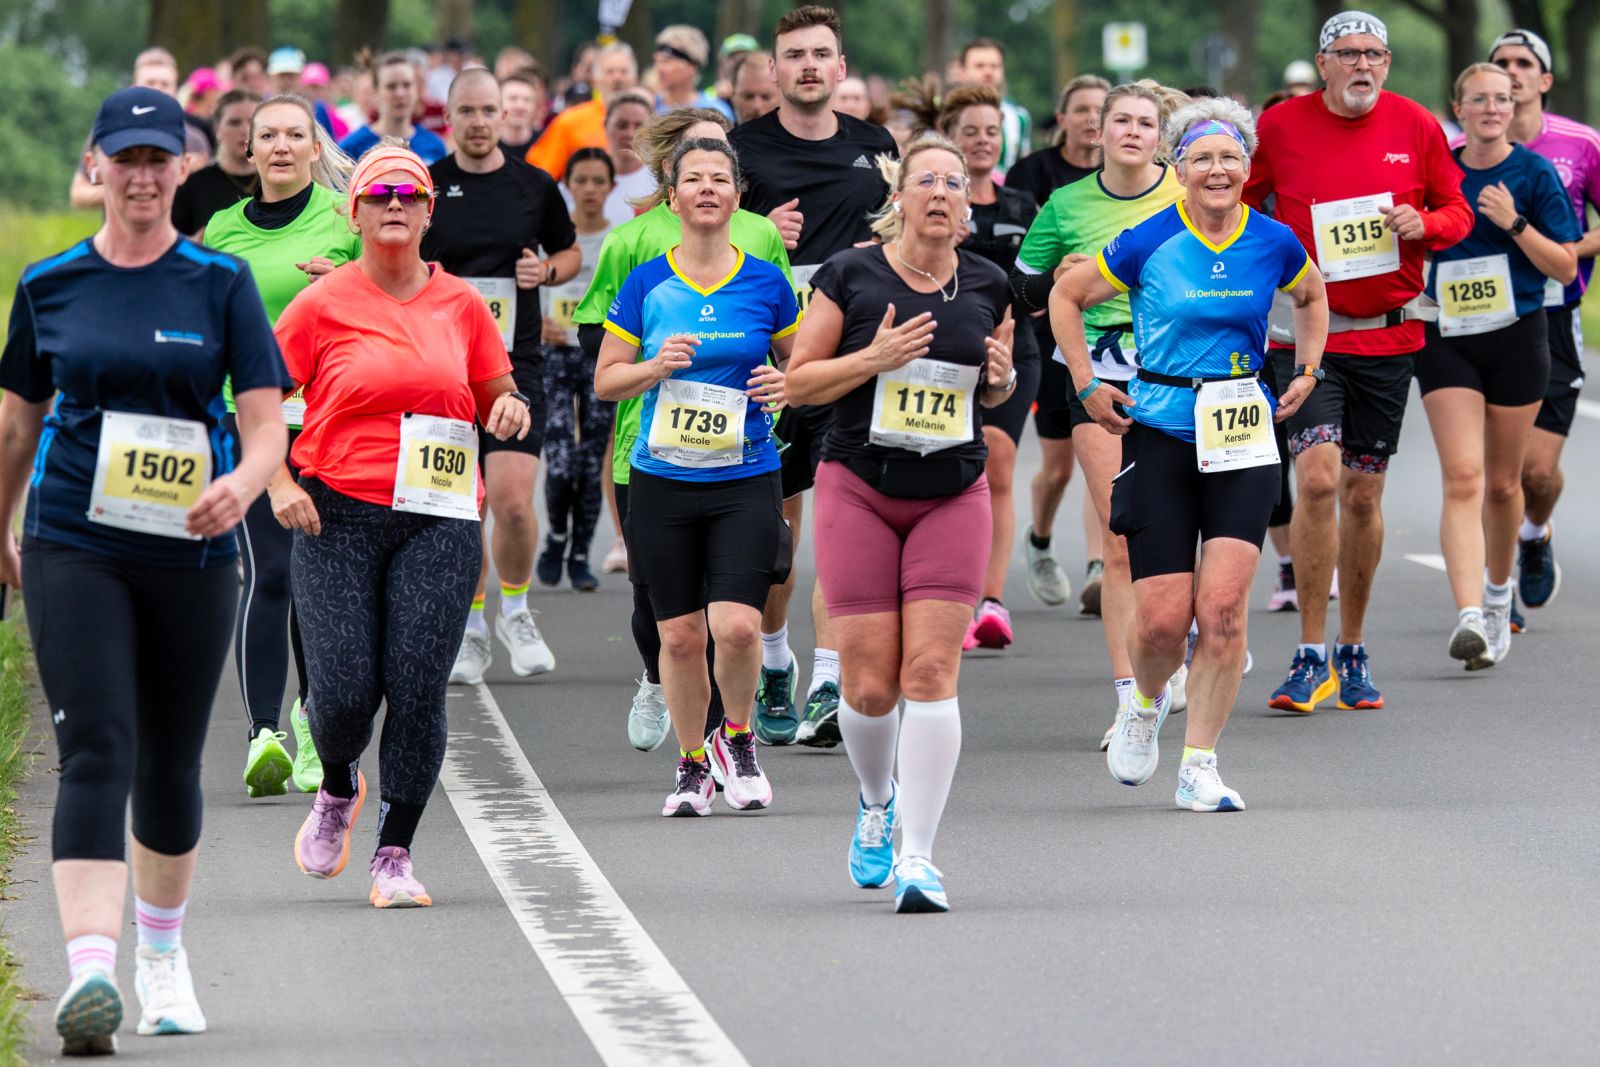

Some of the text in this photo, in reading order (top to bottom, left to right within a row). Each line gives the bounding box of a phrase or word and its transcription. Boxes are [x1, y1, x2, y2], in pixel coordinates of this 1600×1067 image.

[1330, 220, 1383, 245] 1315
[1342, 244, 1376, 255] Michael
[1185, 288, 1253, 298] LG Oerlinghausen
[1448, 280, 1497, 303] 1285
[897, 387, 956, 418] 1174
[671, 407, 727, 435] 1739
[905, 417, 946, 431] Melanie
[1212, 404, 1260, 431] 1740
[680, 434, 711, 446] Nicole
[1224, 433, 1251, 443] Kerstin
[123, 449, 195, 486] 1502
[419, 445, 466, 476] 1630
[431, 475, 453, 488] Nicole
[132, 484, 179, 500] Antonia
